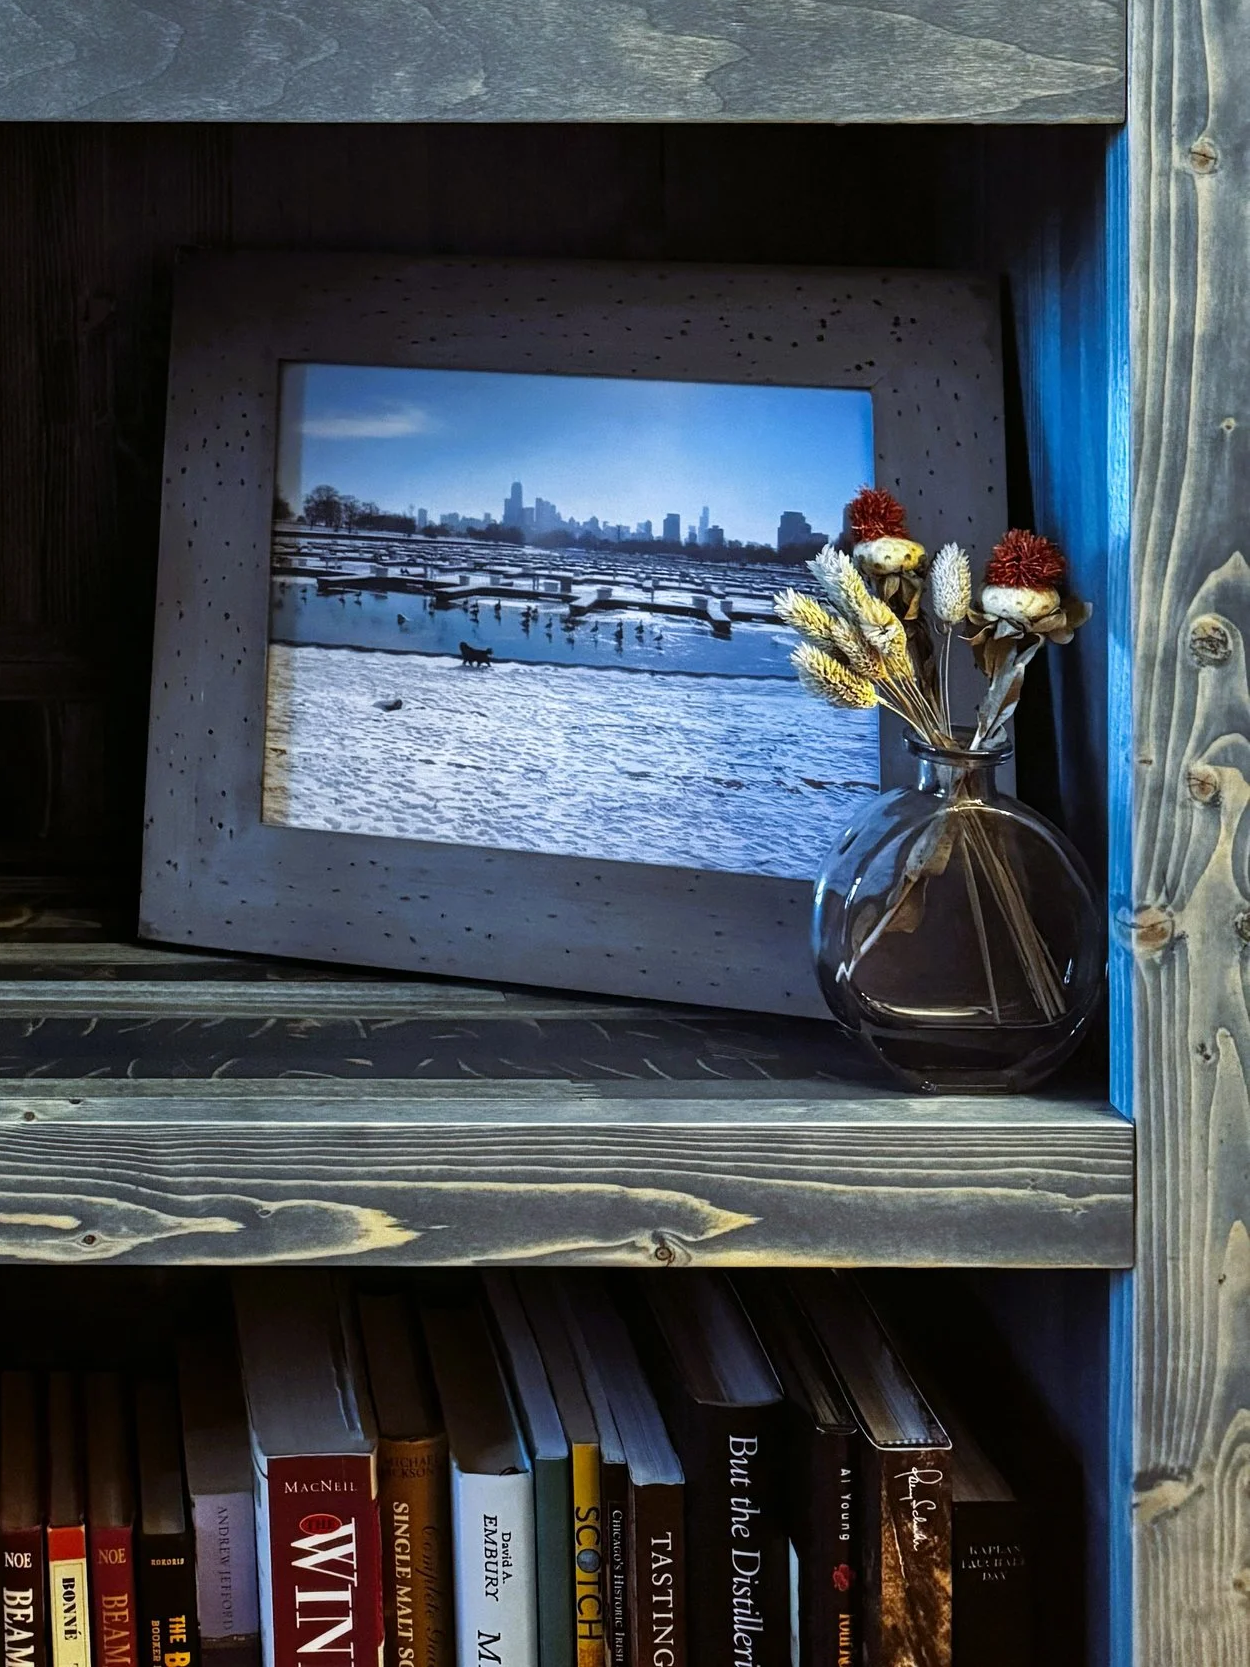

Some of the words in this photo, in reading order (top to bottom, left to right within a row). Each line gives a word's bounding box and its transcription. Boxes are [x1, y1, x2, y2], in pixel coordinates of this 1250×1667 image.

[4, 1552, 32, 1568] NOE
[100, 1548, 126, 1564] NOE
[393, 1502, 411, 1579] SINGLE
[483, 1514, 499, 1601] EMBURY
[501, 1531, 511, 1566] David
[502, 1570, 513, 1584] A.
[62, 1577, 82, 1641] BONNÉ
[102, 1594, 131, 1664] BEAM
[396, 1585, 414, 1640] MALT
